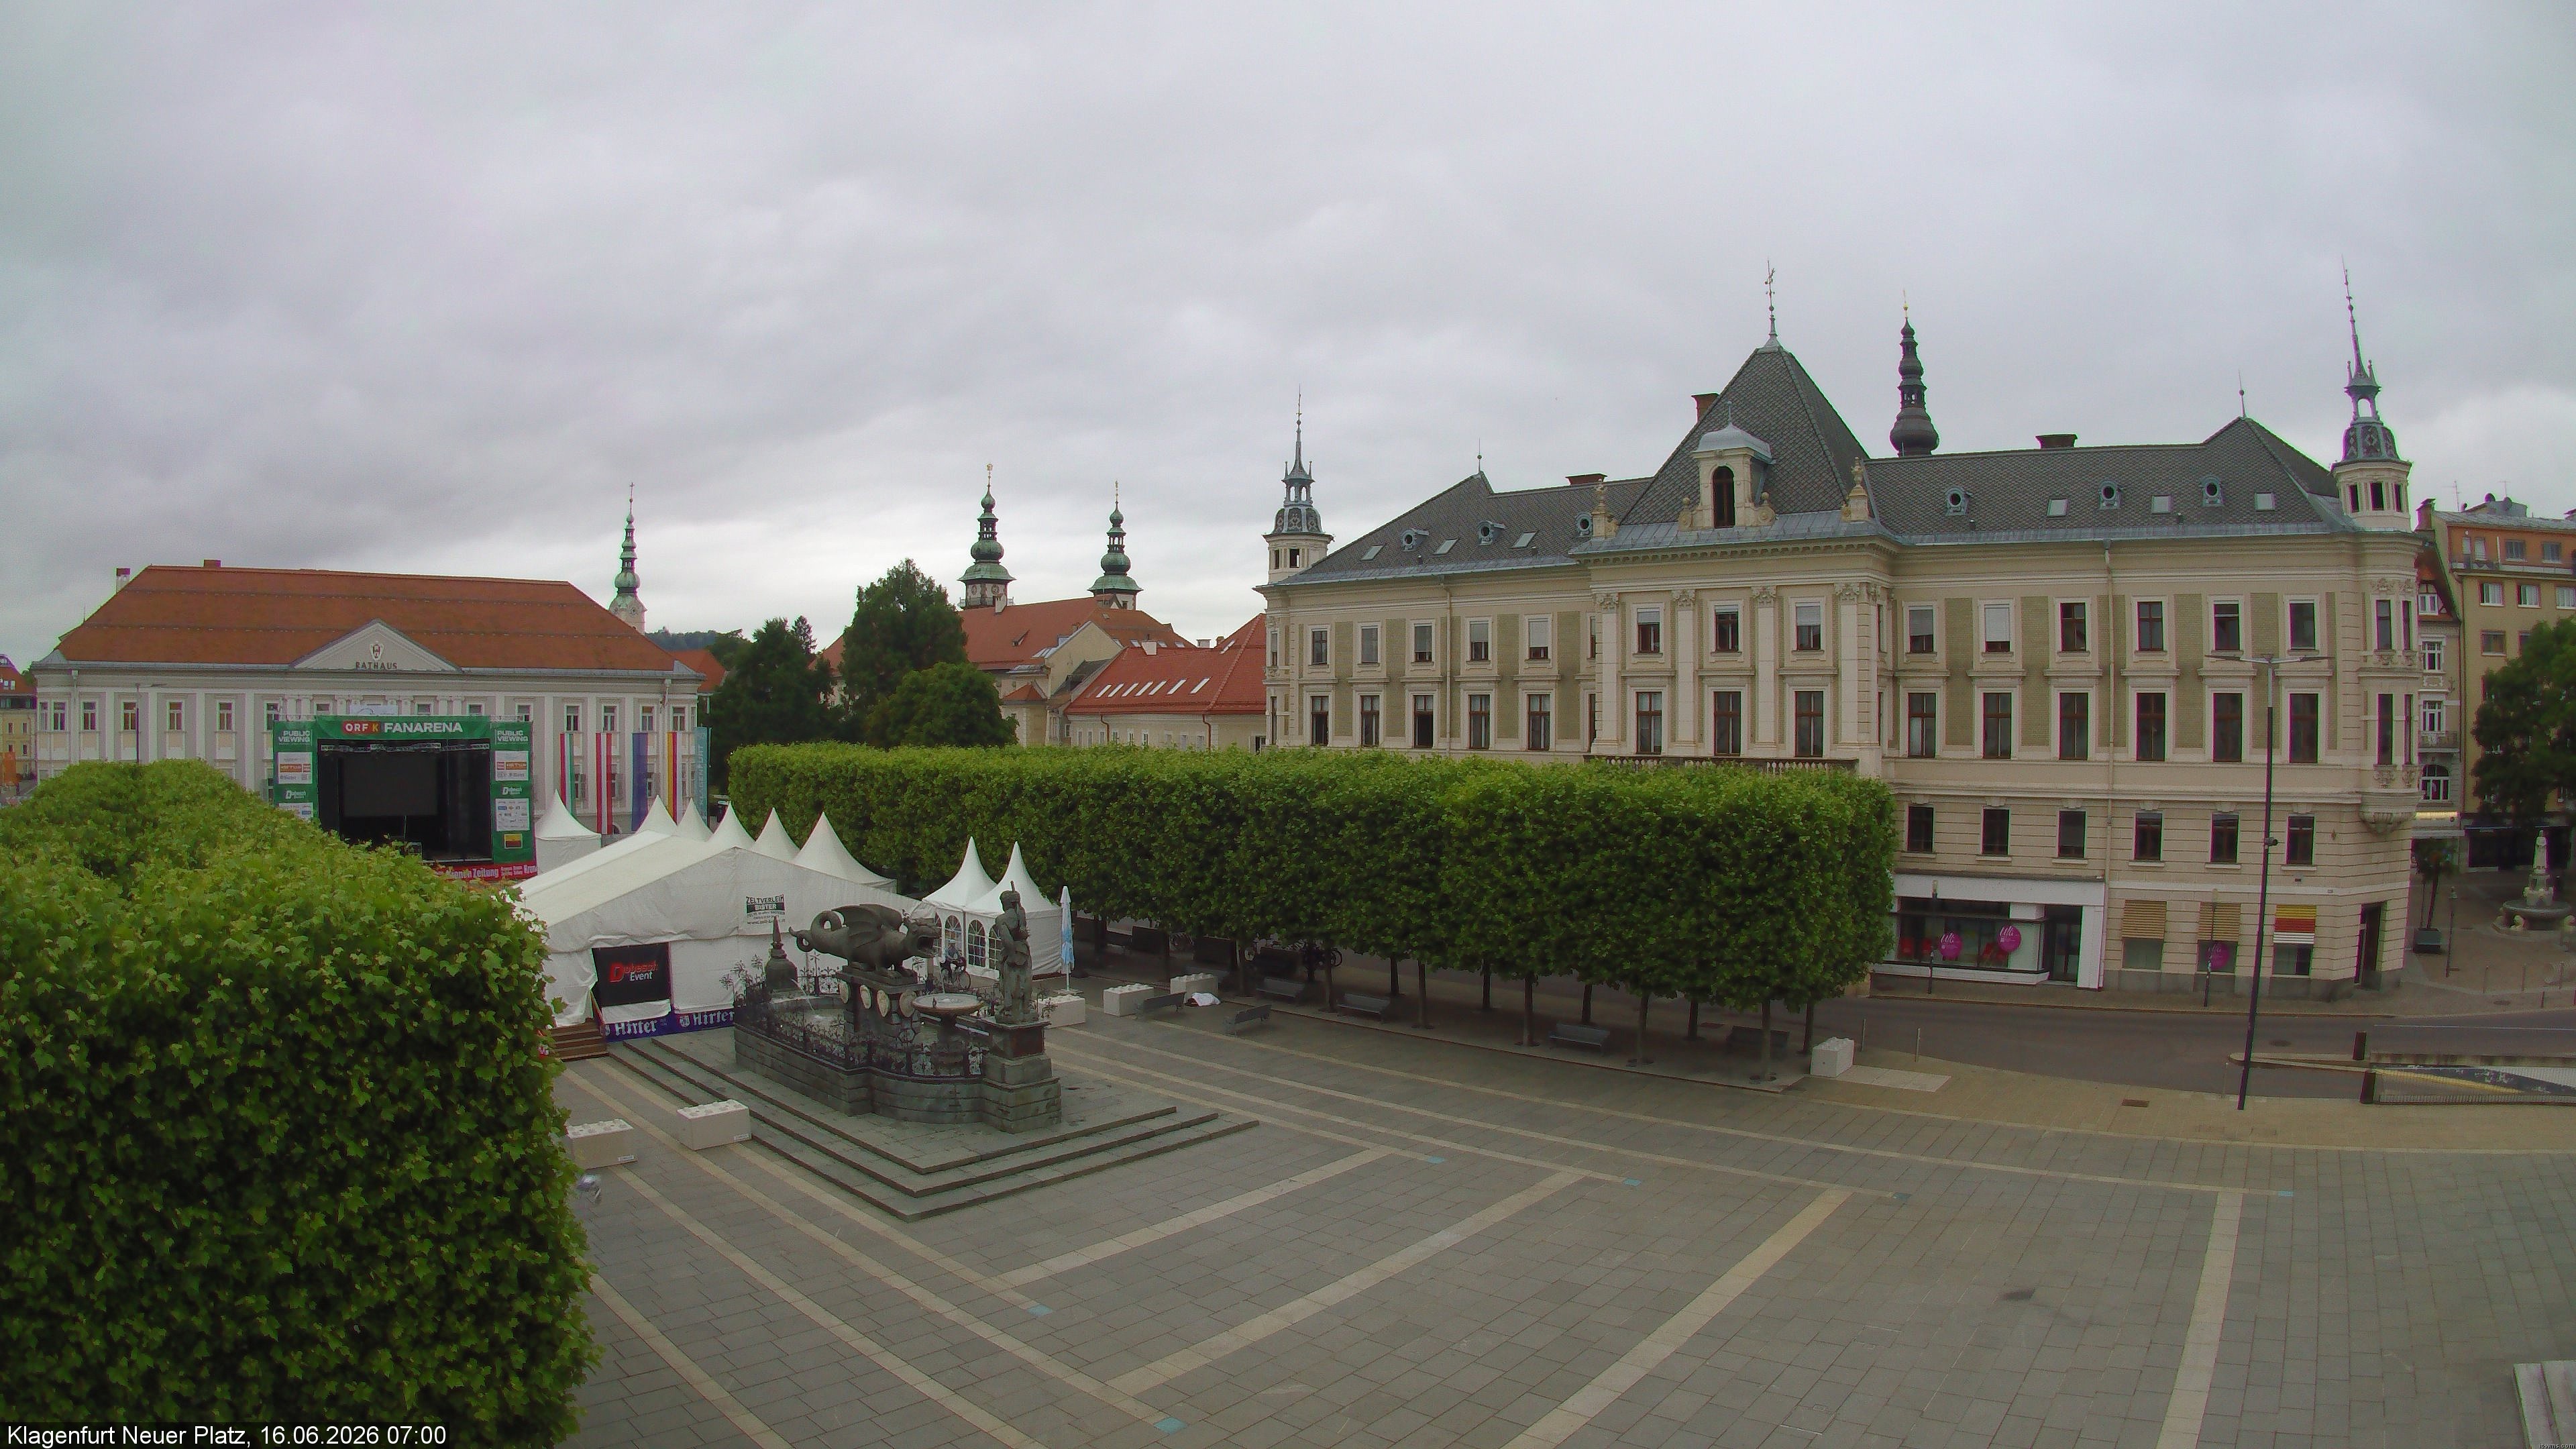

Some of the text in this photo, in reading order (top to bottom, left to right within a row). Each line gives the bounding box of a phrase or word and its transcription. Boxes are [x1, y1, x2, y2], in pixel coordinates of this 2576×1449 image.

[356, 661, 397, 669] RATHAUS
[345, 722, 368, 732] ORF
[384, 722, 463, 733] FANARENA
[472, 867, 499, 878] Zeitung
[746, 894, 784, 904] ZELTVERLEIH
[630, 971, 653, 981] Event
[693, 1010, 735, 1026] Hirter
[615, 1019, 658, 1036] Hirter
